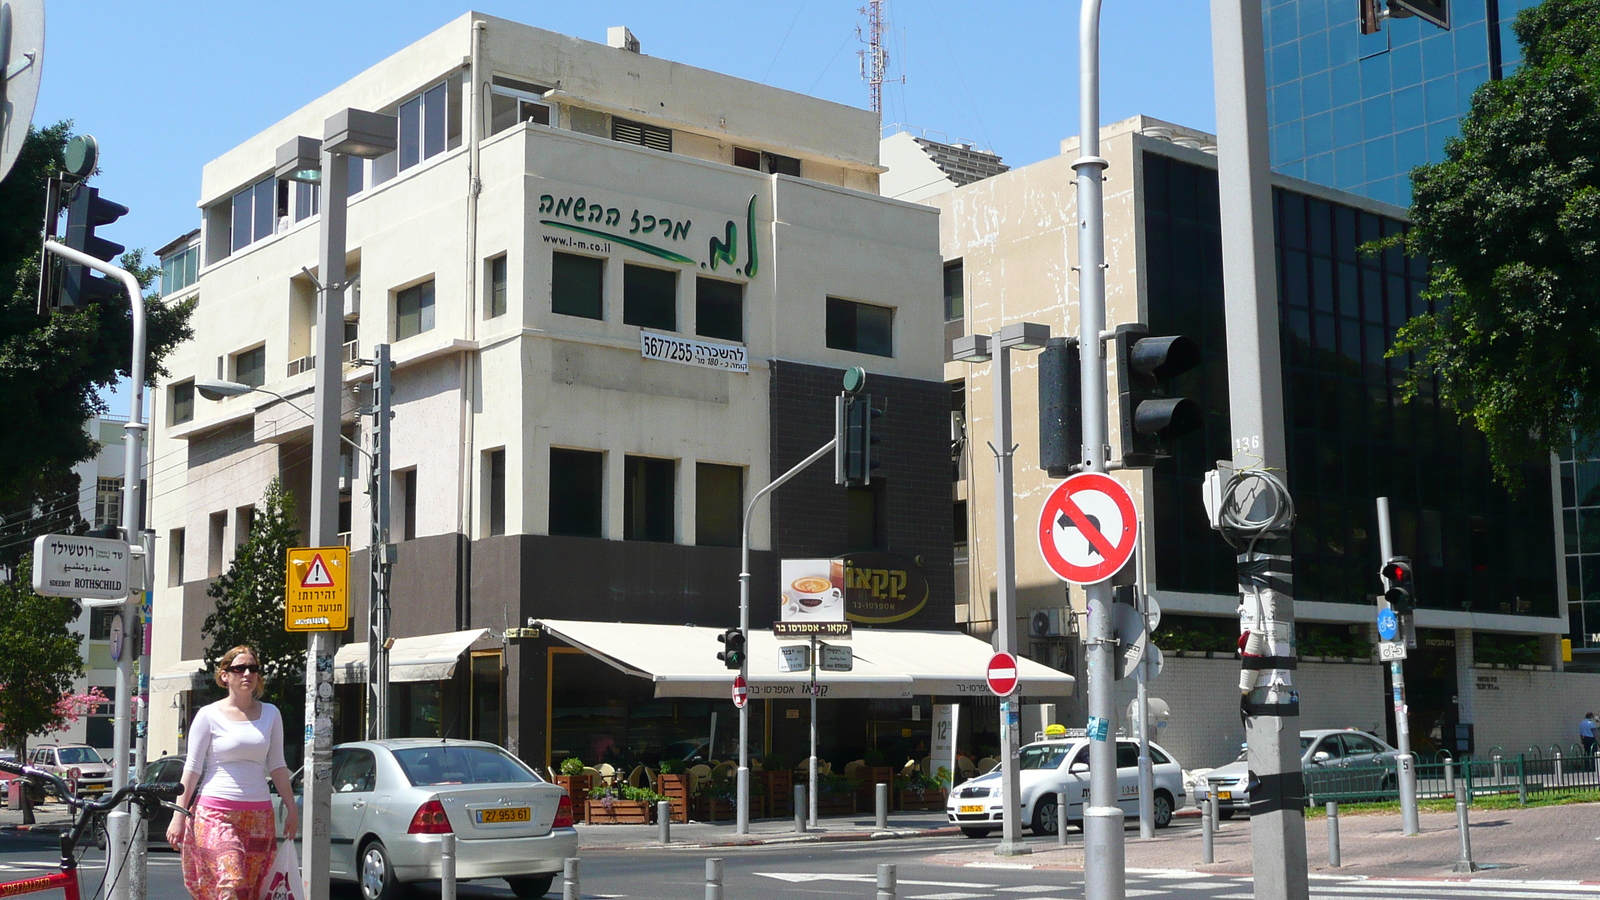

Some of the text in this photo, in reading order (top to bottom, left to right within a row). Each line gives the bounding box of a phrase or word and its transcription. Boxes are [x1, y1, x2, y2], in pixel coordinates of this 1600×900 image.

[539, 194, 692, 241] מרכז ההשמה
[542, 233, 611, 253] www.l-m.co.il
[644, 336, 693, 362] 5677255
[695, 345, 744, 361] להשכרה
[707, 357, 719, 367] 180
[730, 362, 748, 371] קומה
[1235, 435, 1260, 452] 136
[51, 541, 94, 557] רוטשילד
[74, 578, 122, 591] ROTHSCHILD
[298, 591, 336, 600] זהירות!
[292, 604, 342, 613] תנועה חוצה
[776, 624, 786, 632] בר
[788, 623, 819, 633] אספרסו
[827, 623, 848, 634] קקאו
[937, 720, 947, 740] 12
[1402, 759, 1409, 770] 5
[2, 877, 51, 896] SPECIALIZED
